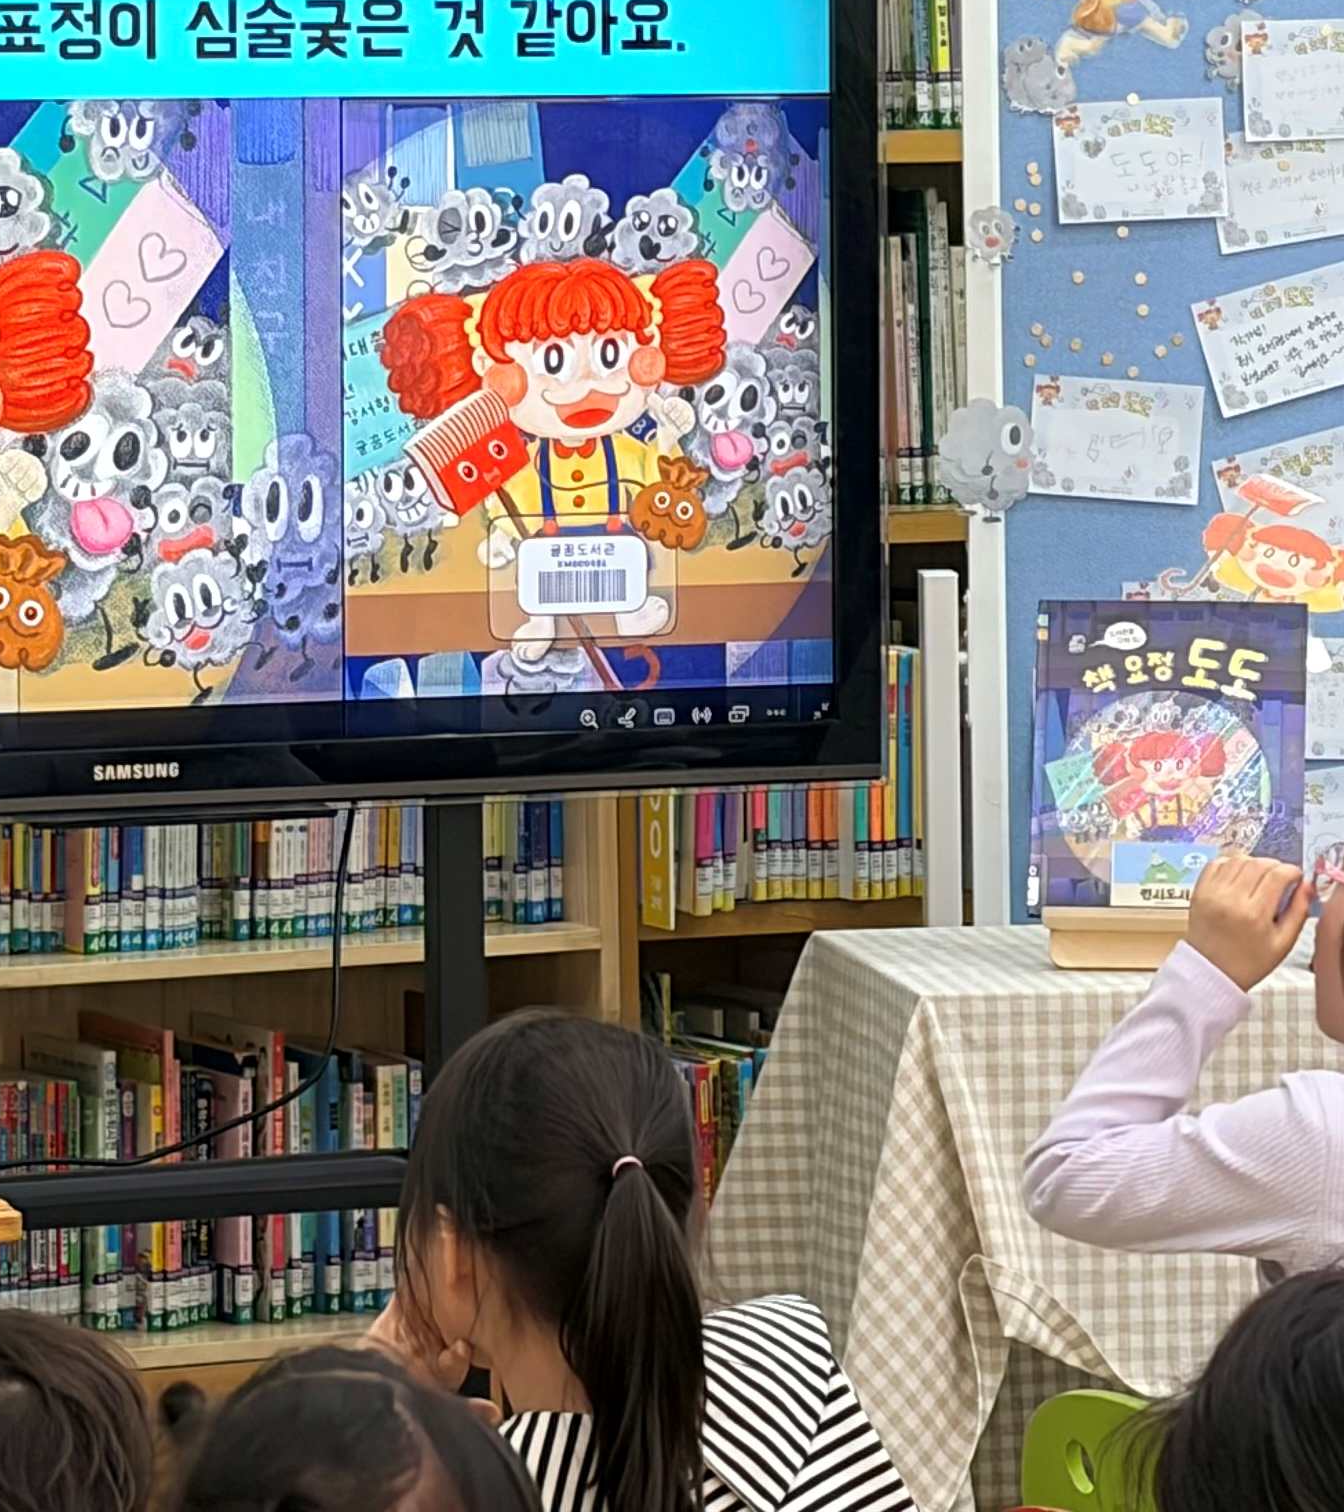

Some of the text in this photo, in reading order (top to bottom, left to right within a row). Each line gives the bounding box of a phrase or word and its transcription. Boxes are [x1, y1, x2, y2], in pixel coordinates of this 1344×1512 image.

[1110, 141, 1206, 178] 도도야!
[1082, 663, 1116, 694] 책
[1124, 650, 1176, 685] 요정
[1181, 637, 1270, 701] 도도
[93, 762, 180, 781] SAMSUNG
